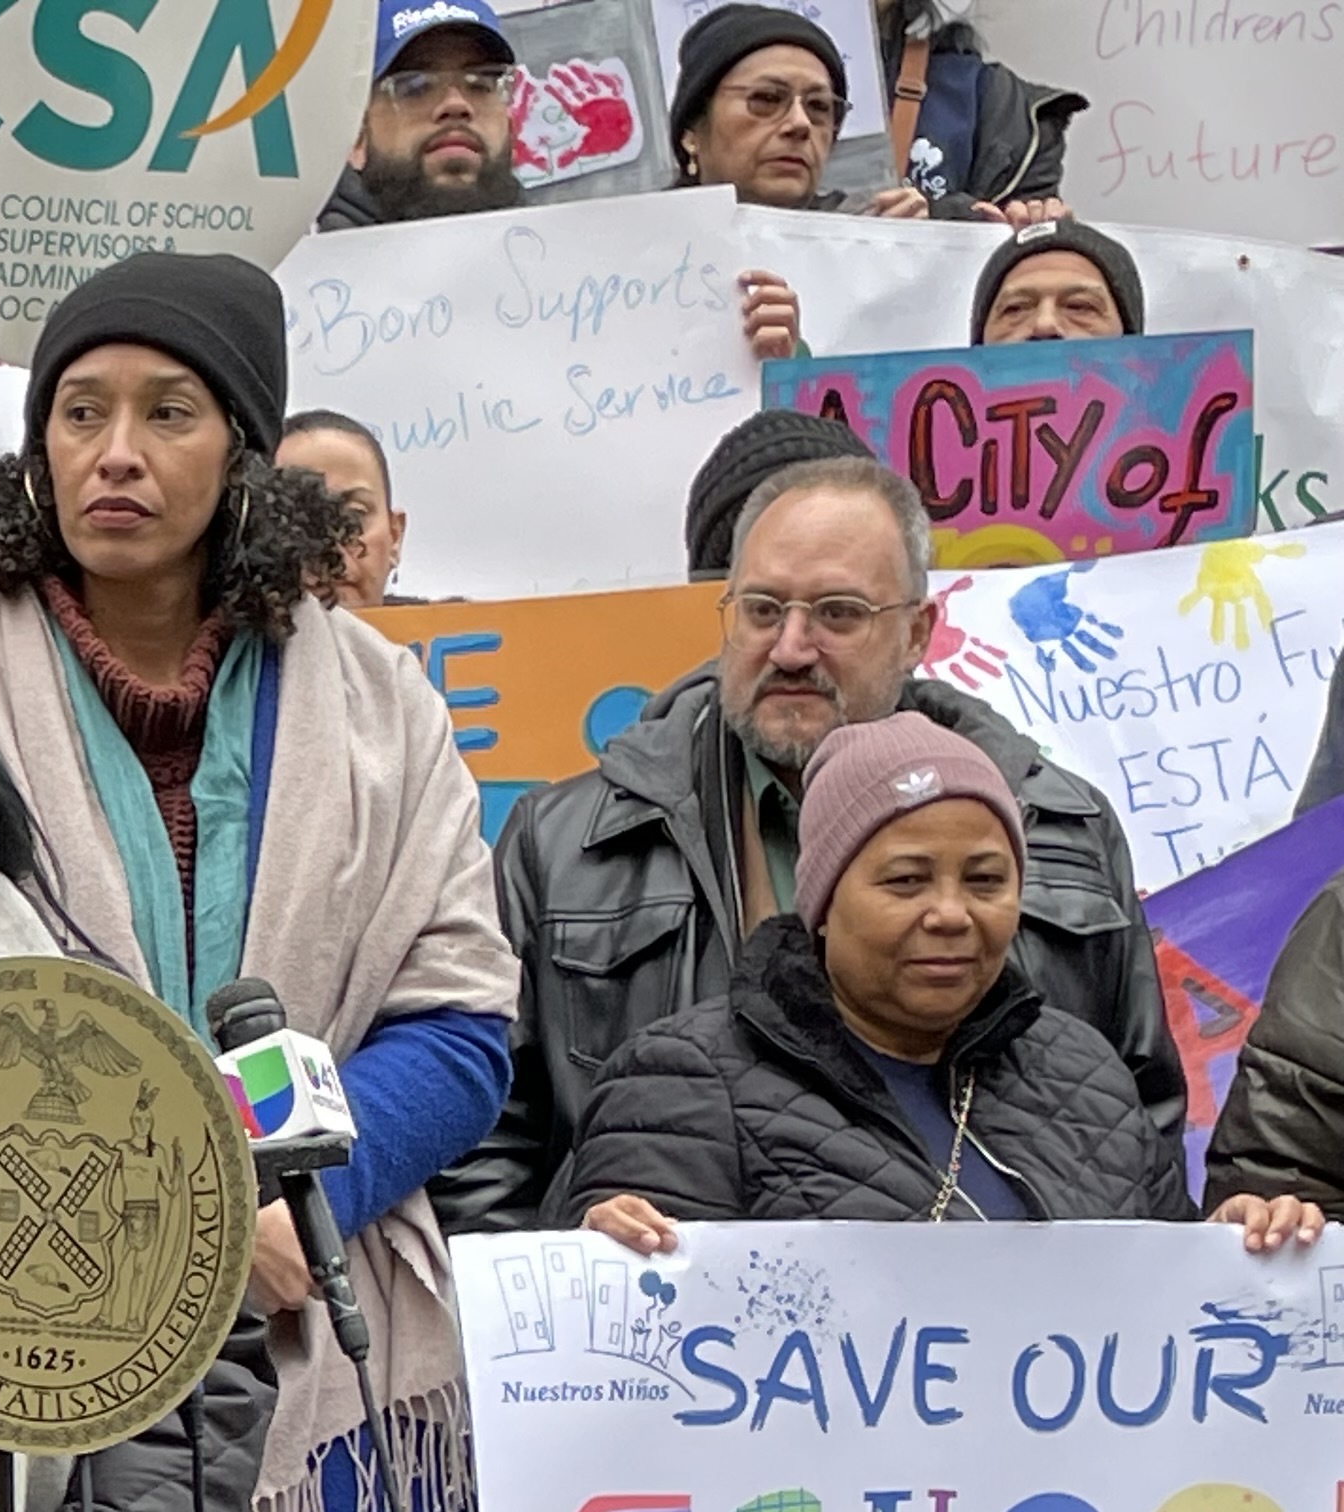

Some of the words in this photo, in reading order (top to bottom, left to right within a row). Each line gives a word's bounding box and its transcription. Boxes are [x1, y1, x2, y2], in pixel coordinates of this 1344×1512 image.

[1098, 100, 1340, 197] future
[0, 194, 121, 226] COUNCIL
[127, 201, 159, 228] OF
[163, 203, 255, 231] SCHOOL
[496, 226, 727, 341] Supports
[367, 384, 543, 454] ublic
[1106, 392, 1239, 551] of
[1004, 645, 1242, 727] Nuestro
[1118, 712, 1294, 814] ESTÁ
[93, 1338, 176, 1405] NOVI
[170, 1186, 220, 1343] EBORACI
[13, 1344, 76, 1373] 1625
[501, 1380, 604, 1403] Nuestros
[607, 1376, 670, 1402] Niños
[673, 1317, 971, 1433] SAVE
[1011, 1321, 1280, 1433] OUR
